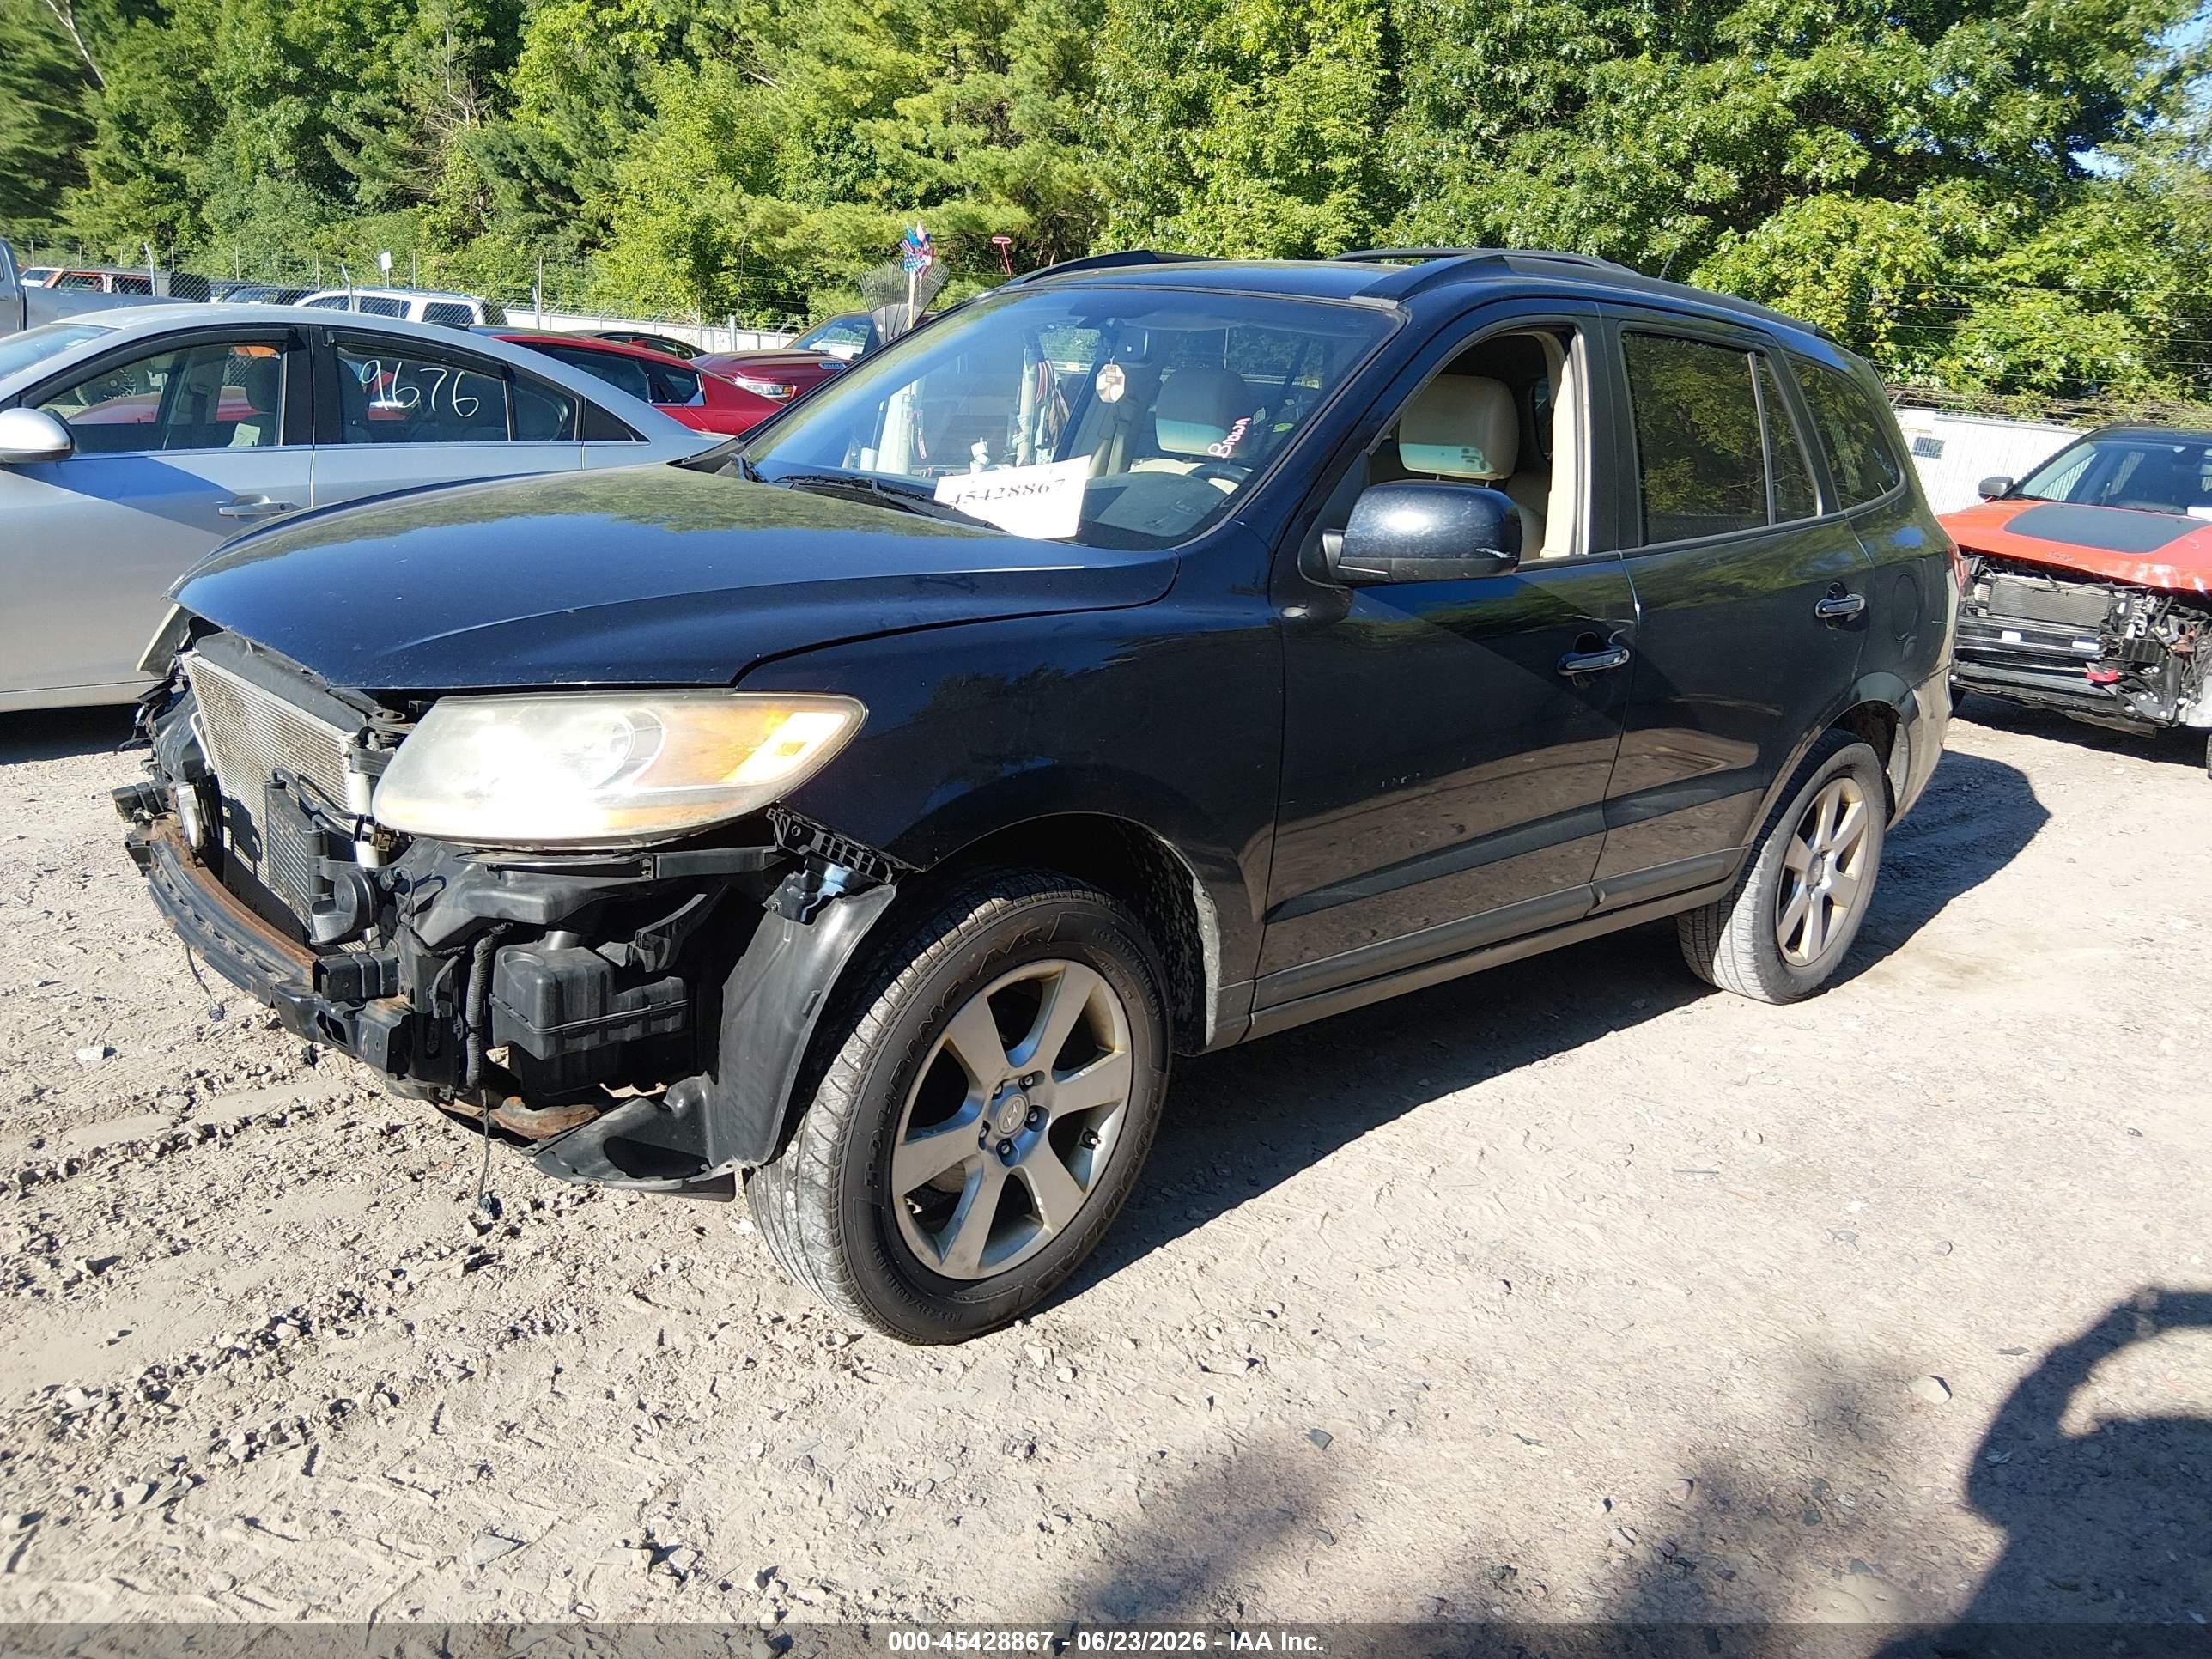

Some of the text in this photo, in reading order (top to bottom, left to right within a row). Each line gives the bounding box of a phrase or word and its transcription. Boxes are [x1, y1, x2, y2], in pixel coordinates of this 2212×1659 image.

[359, 359, 479, 417] 9676
[1208, 417, 1252, 459] Brown
[949, 478, 1066, 504] 45428867
